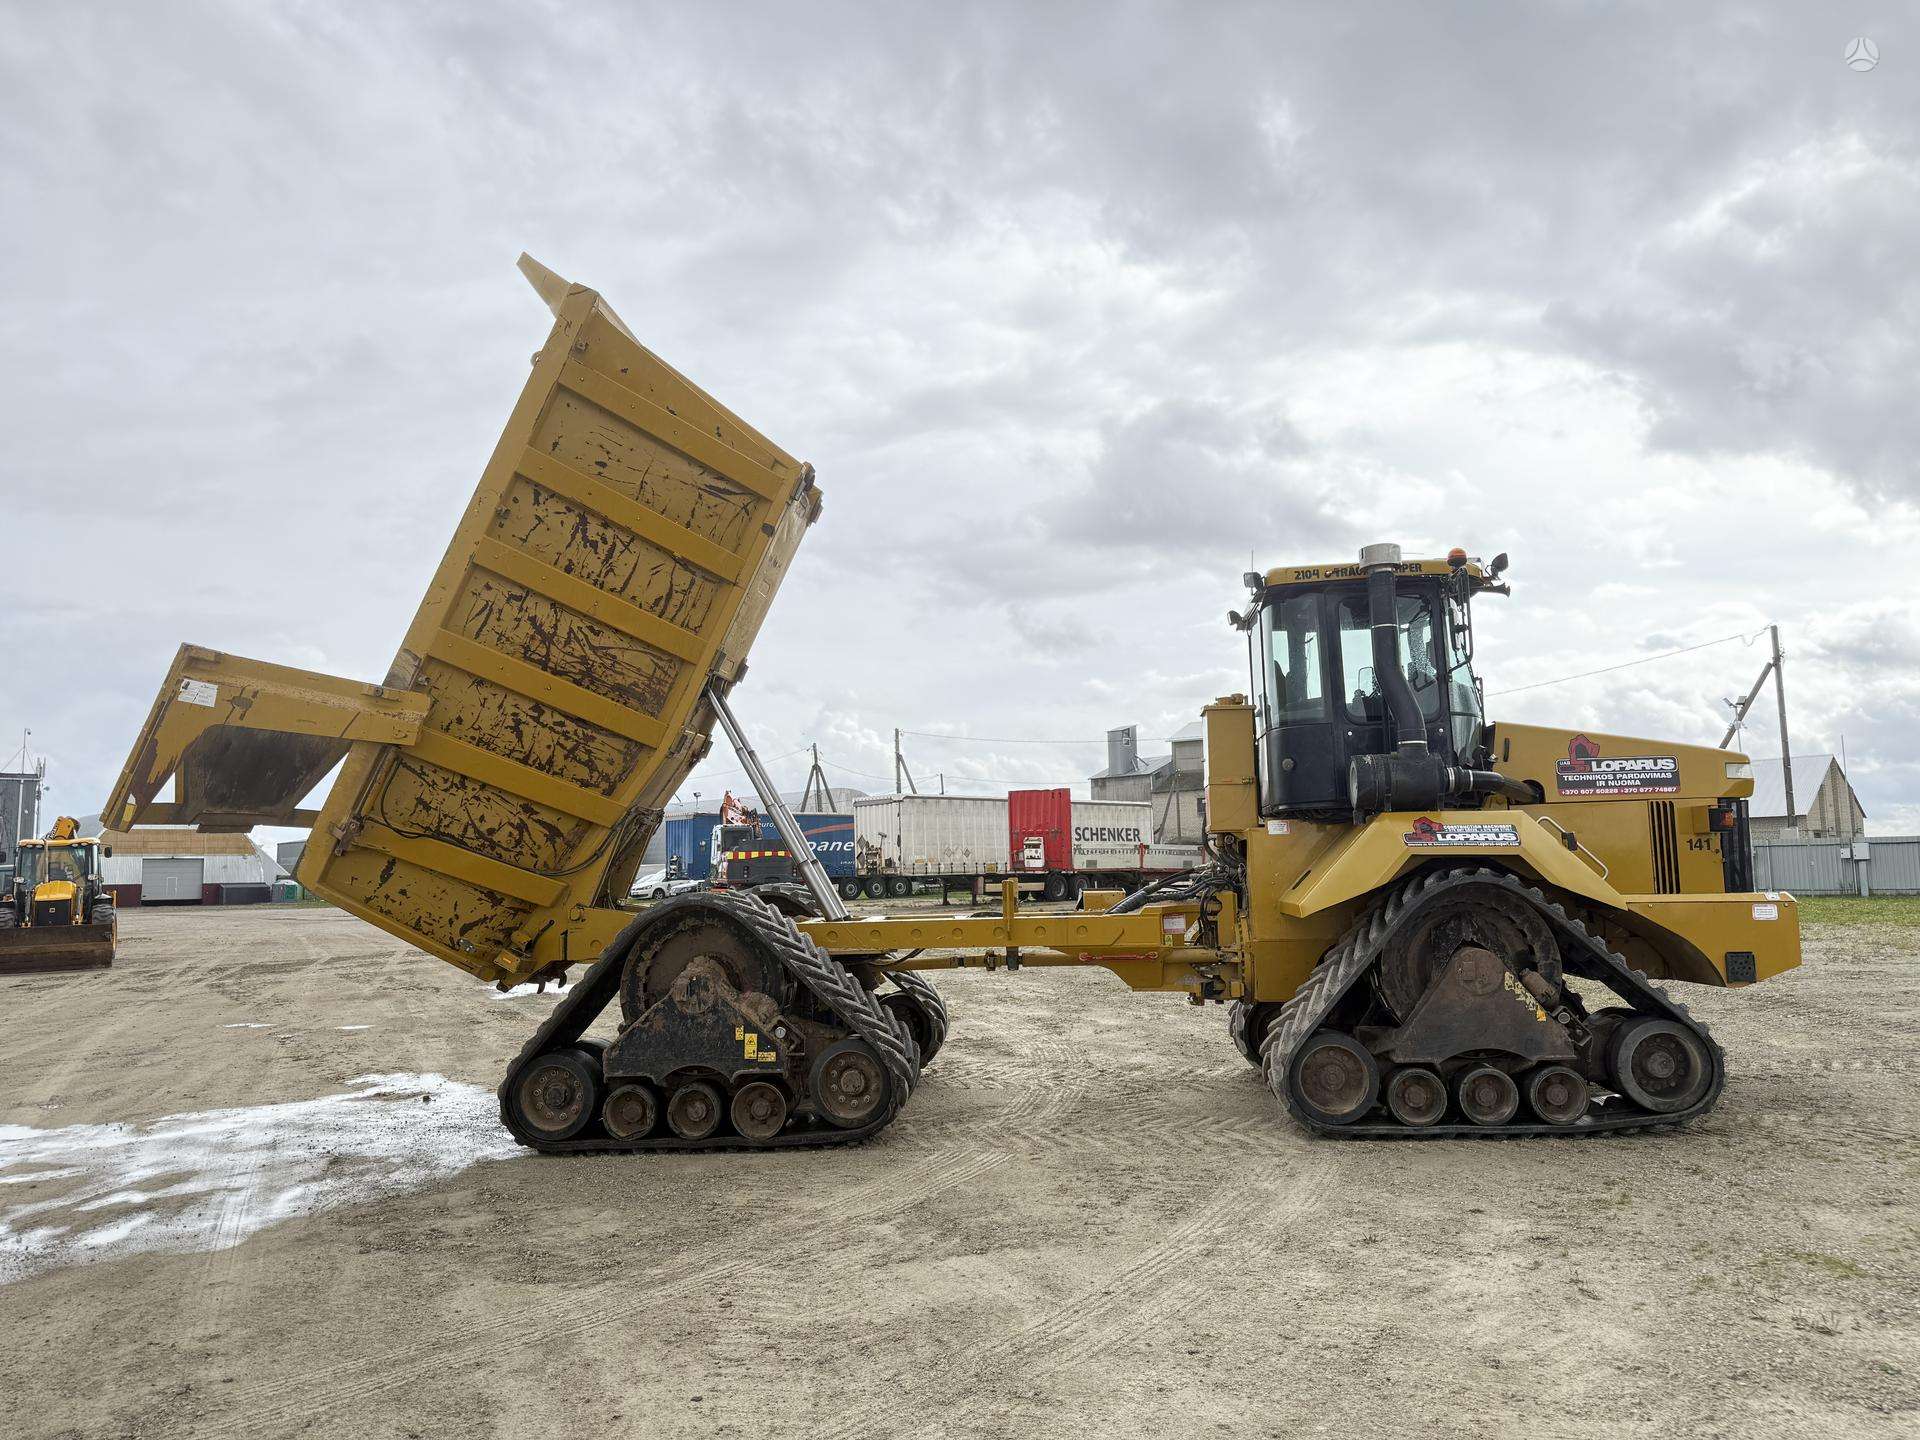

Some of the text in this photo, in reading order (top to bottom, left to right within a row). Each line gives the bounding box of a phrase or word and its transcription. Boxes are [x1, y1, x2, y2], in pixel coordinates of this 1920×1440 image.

[1294, 569, 1320, 580] 2104
[1591, 758, 1675, 772] LOPARUS
[1563, 772, 1673, 781] TECHNIKOS PARDAVIMAS
[1608, 779, 1642, 787] NUOMA
[1074, 826, 1141, 842] SCHENKER
[1436, 833, 1518, 841] LOPARUS
[1686, 838, 1712, 851] 141
